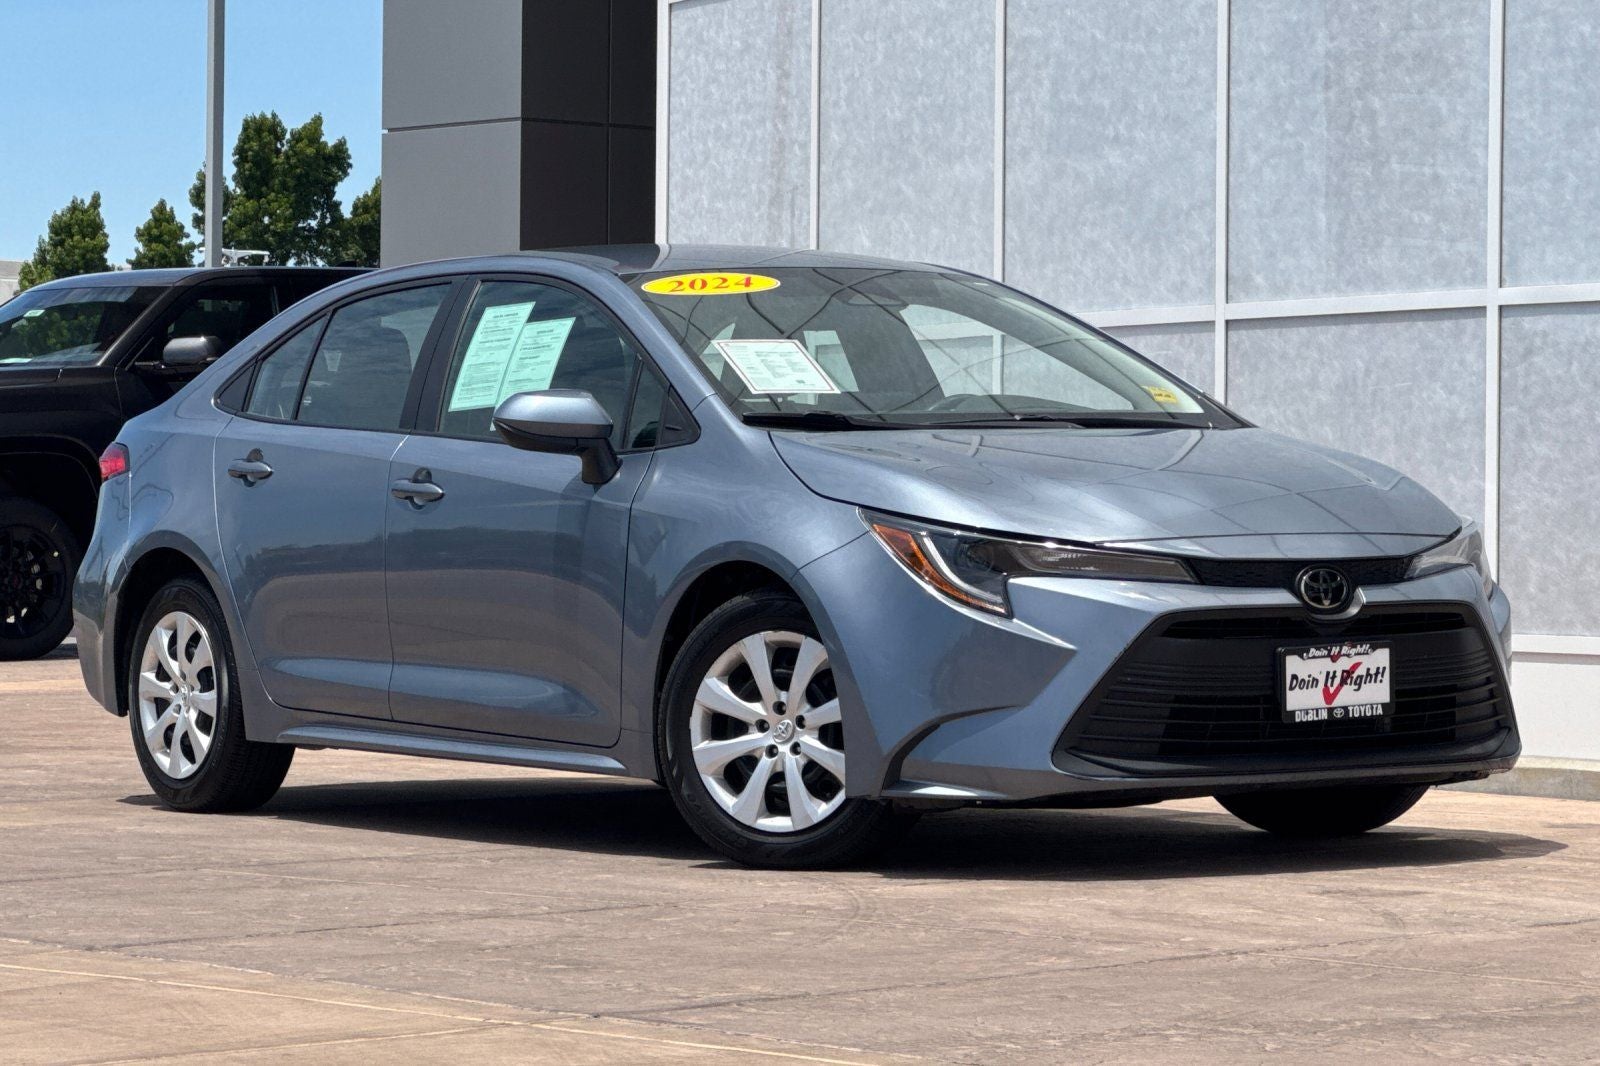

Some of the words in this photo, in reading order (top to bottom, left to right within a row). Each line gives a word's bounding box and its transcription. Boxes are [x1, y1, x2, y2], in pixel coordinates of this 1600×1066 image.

[668, 276, 754, 293] 2024
[1308, 646, 1330, 658] Doin'
[1330, 646, 1340, 656] It
[1341, 643, 1370, 658] Right!
[1288, 671, 1322, 691] Doin'
[1323, 670, 1337, 687] It
[1339, 666, 1386, 691] Right!
[1295, 708, 1328, 722] DUBLIN
[1347, 704, 1383, 718] TOYOTA
